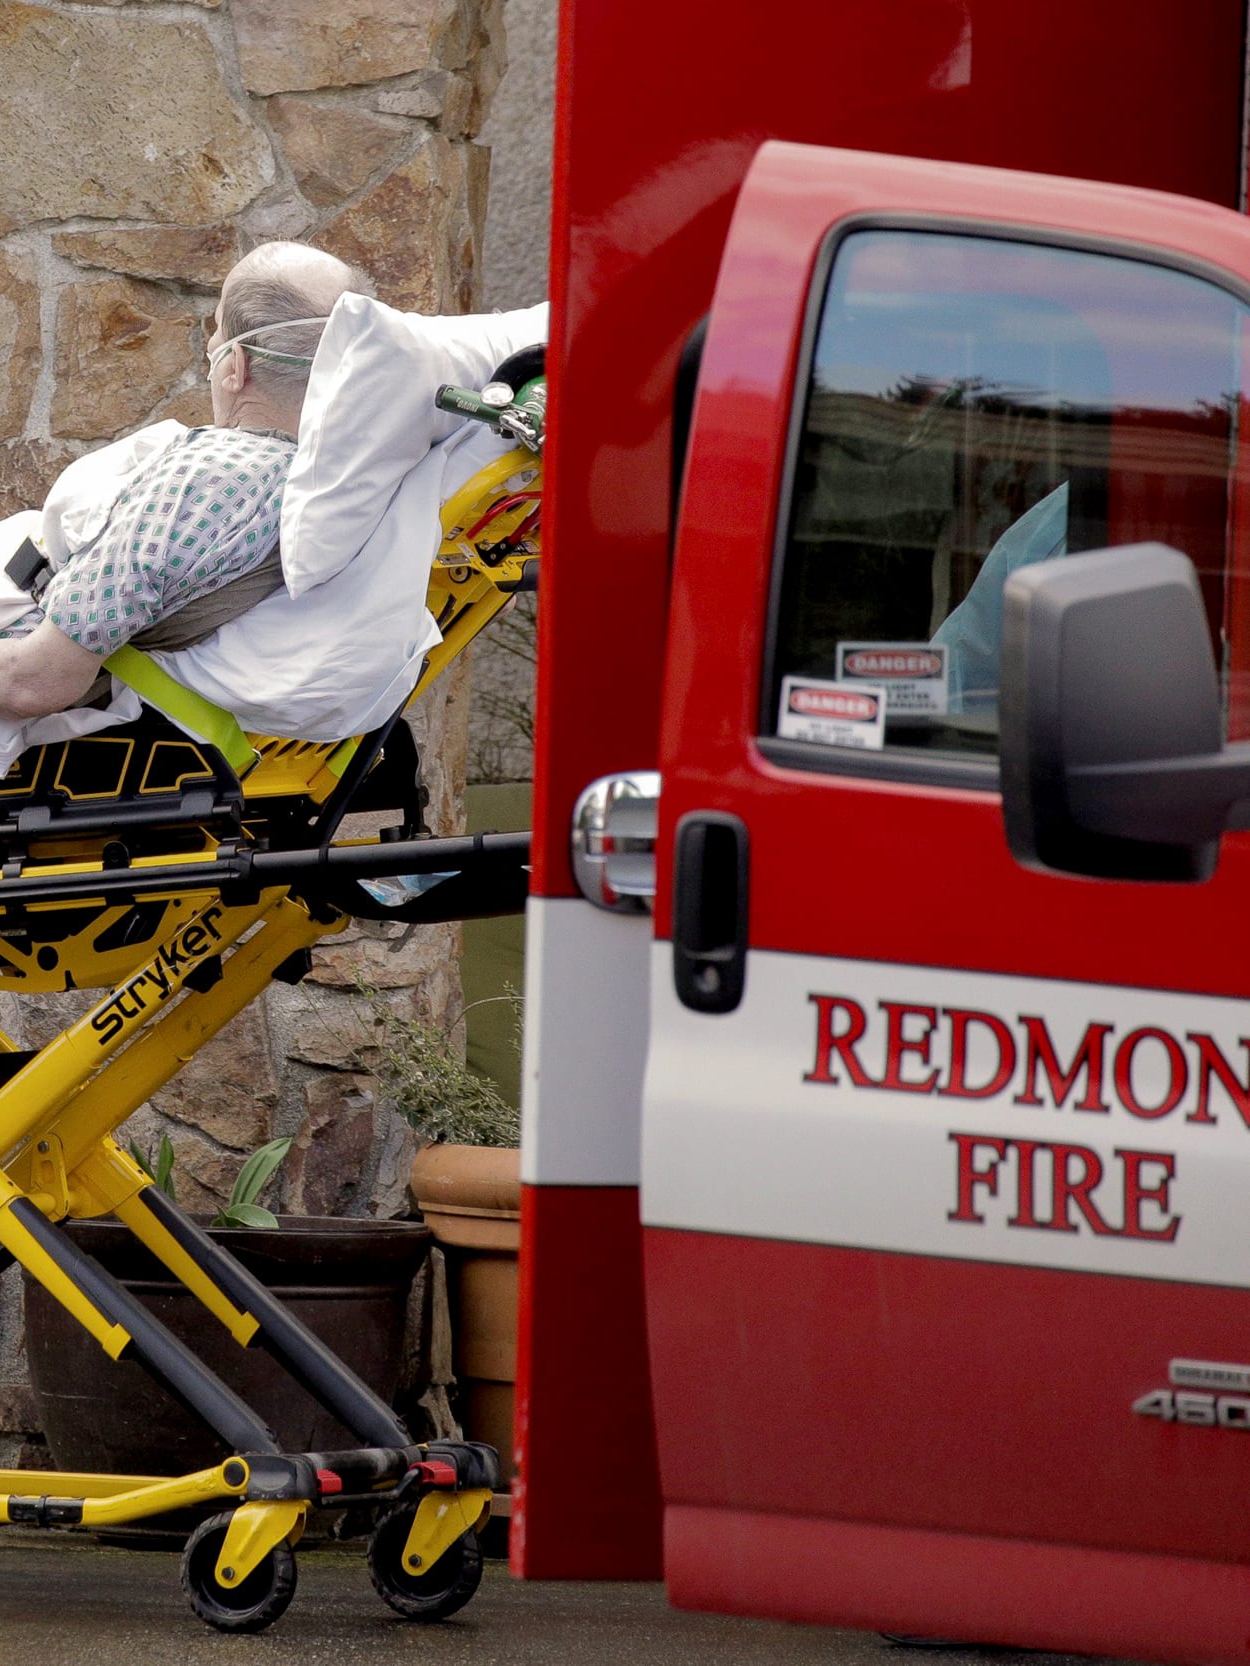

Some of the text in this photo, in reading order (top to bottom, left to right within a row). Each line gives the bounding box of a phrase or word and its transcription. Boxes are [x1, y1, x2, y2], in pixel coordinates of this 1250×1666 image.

[796, 691, 870, 716] DANGER
[854, 655, 932, 672] DANGER
[90, 906, 223, 1047] stryker
[802, 992, 1250, 1131] REDMON
[946, 1131, 1182, 1243] FIRE
